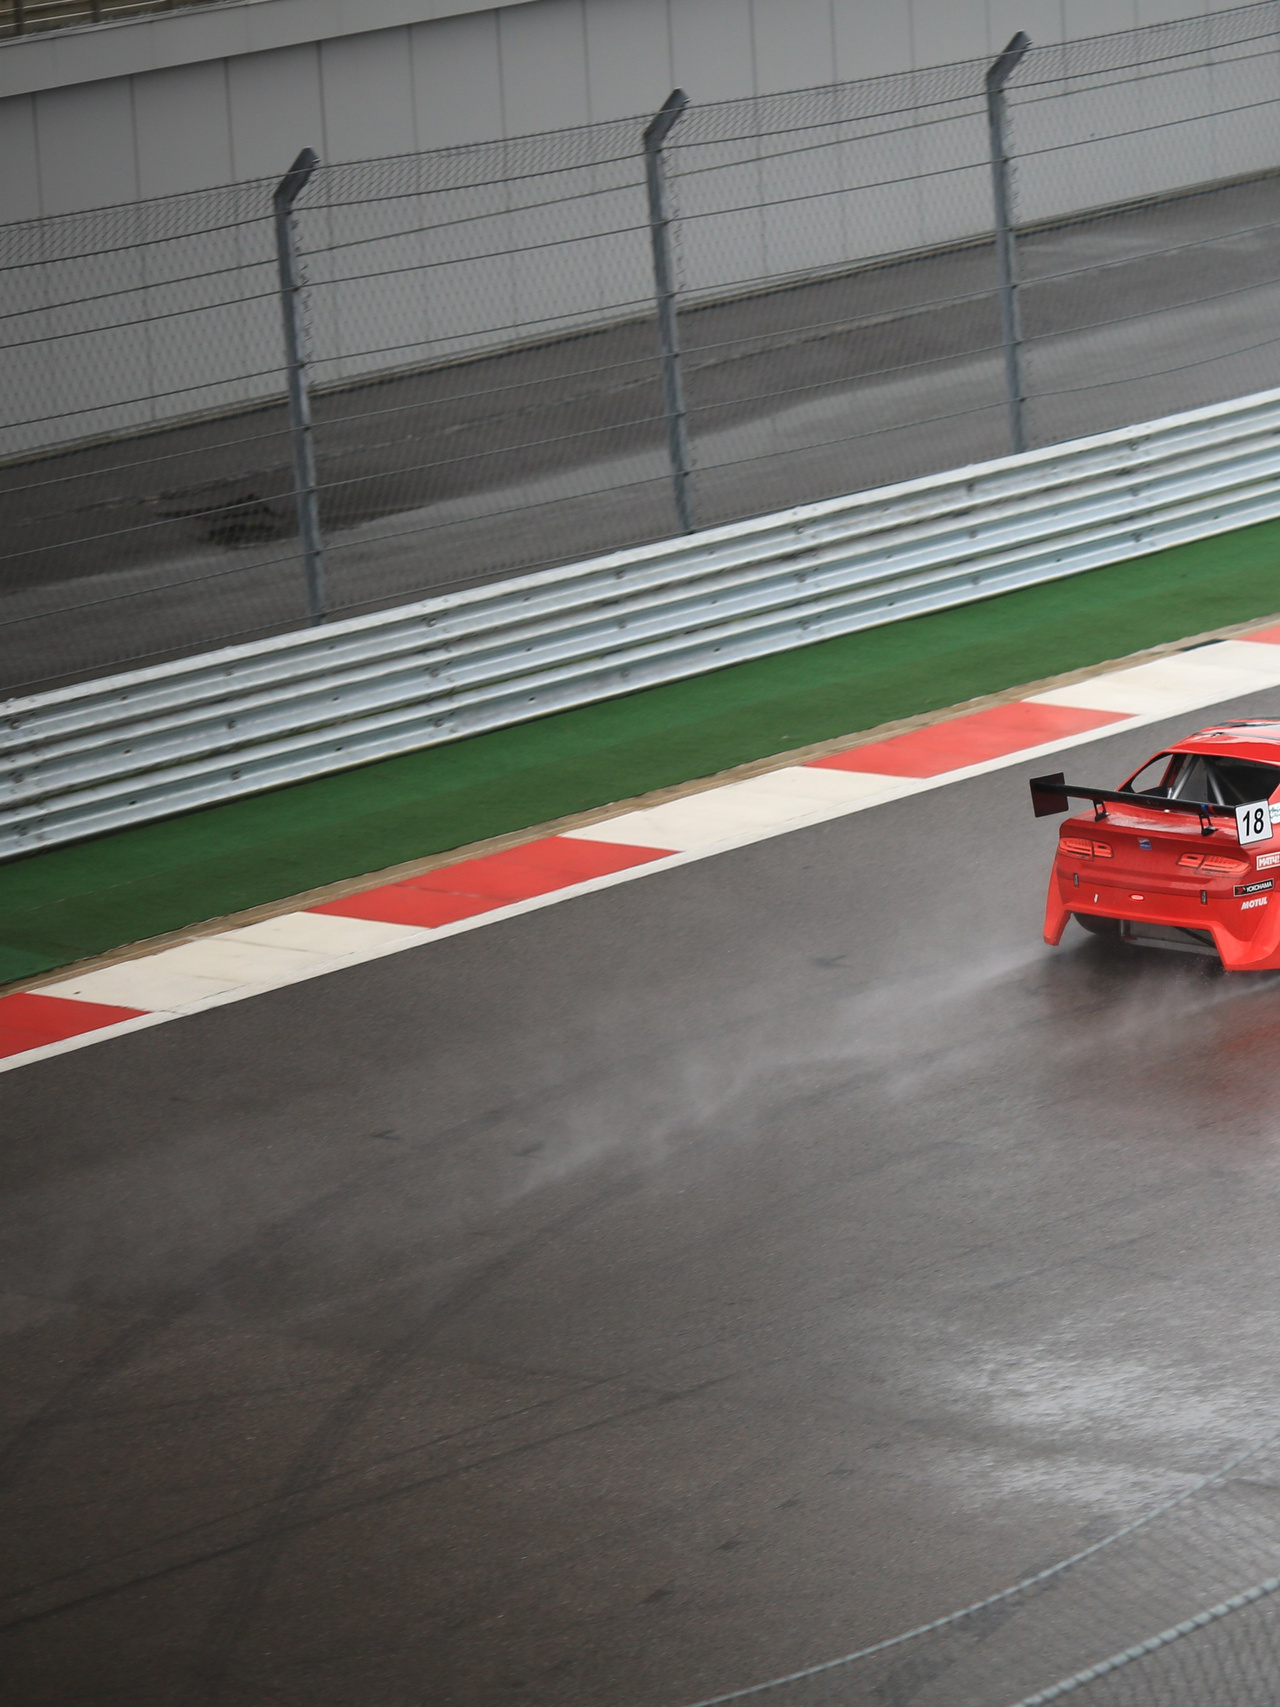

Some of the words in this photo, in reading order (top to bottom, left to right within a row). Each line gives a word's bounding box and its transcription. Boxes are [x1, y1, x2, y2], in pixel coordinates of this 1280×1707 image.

[1242, 808, 1264, 837] 18
[1246, 881, 1273, 893] YOKOHAMA
[1241, 896, 1268, 910] MOTUL
